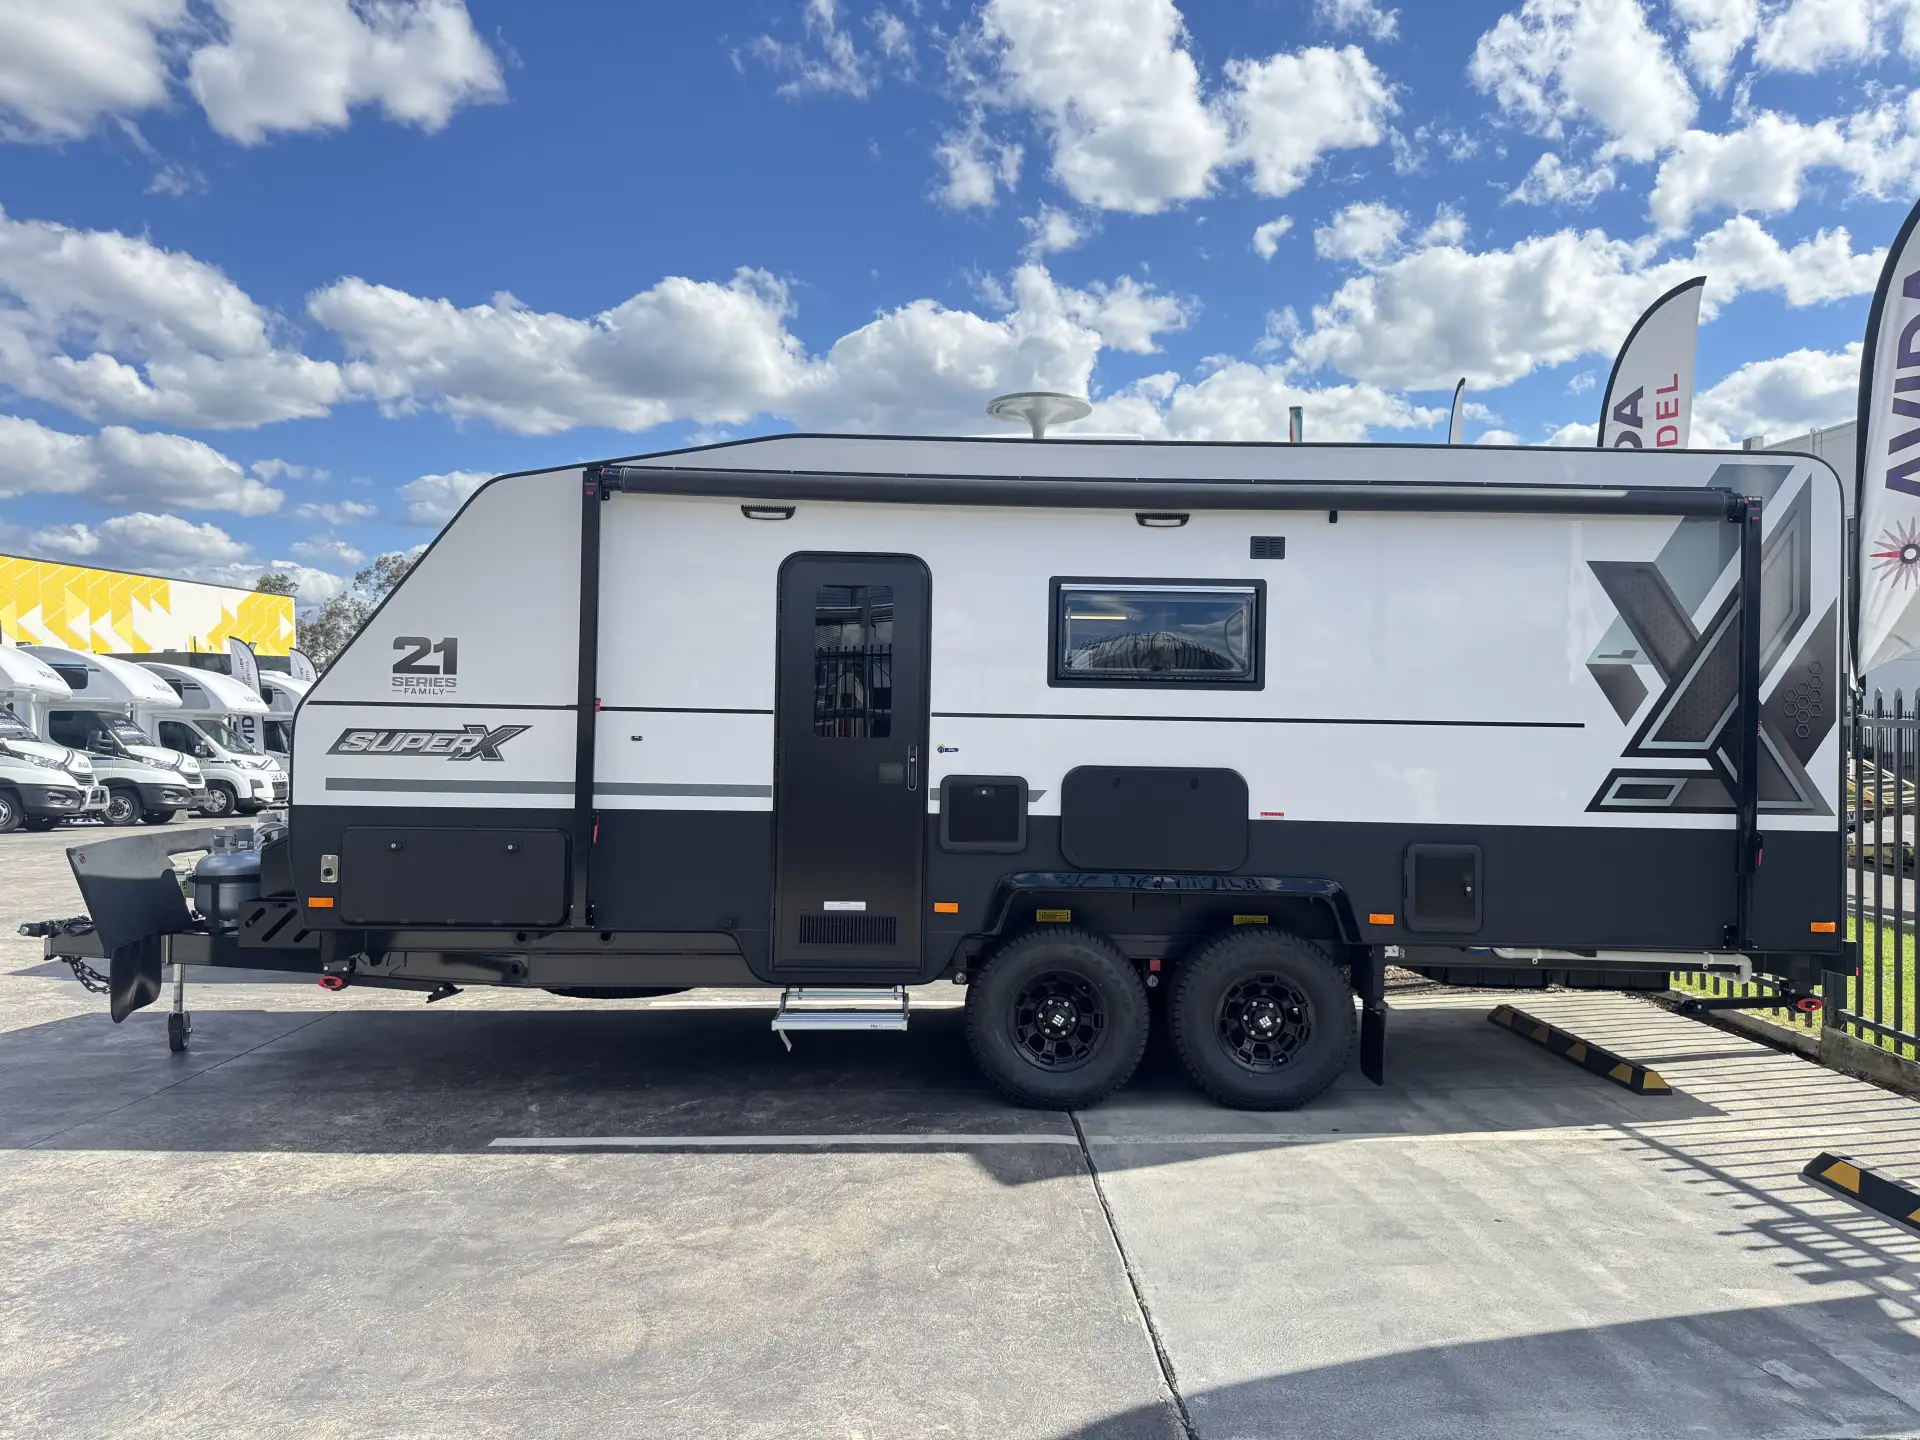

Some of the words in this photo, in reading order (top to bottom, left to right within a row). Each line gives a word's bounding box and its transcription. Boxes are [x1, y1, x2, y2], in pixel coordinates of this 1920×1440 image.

[392, 636, 458, 675] 21
[391, 676, 457, 688] SERIES
[404, 687, 445, 695] FAMILY
